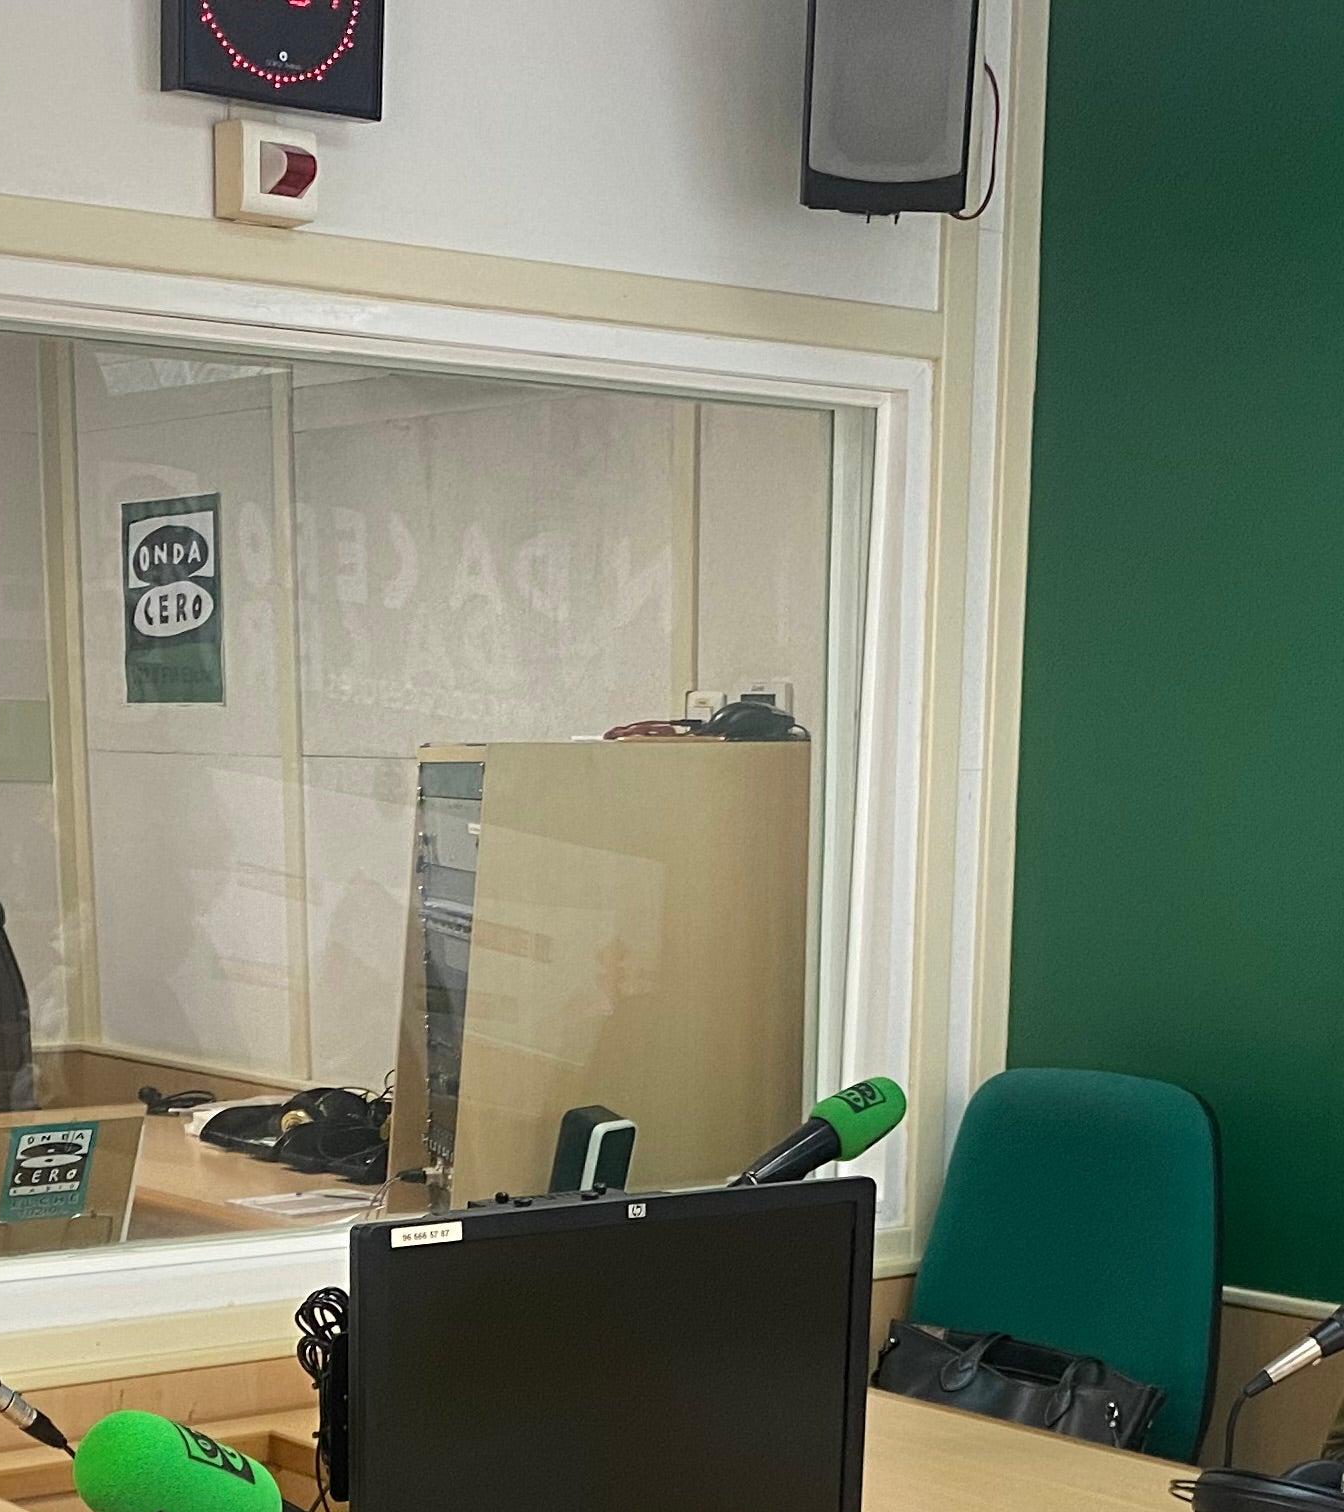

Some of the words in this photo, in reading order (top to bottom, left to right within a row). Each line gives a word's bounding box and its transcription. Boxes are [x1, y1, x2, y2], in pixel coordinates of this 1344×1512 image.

[139, 540, 202, 572] ONDA
[143, 593, 203, 626] CERO
[27, 1131, 85, 1145] ONDA
[13, 1168, 78, 1184] CERO
